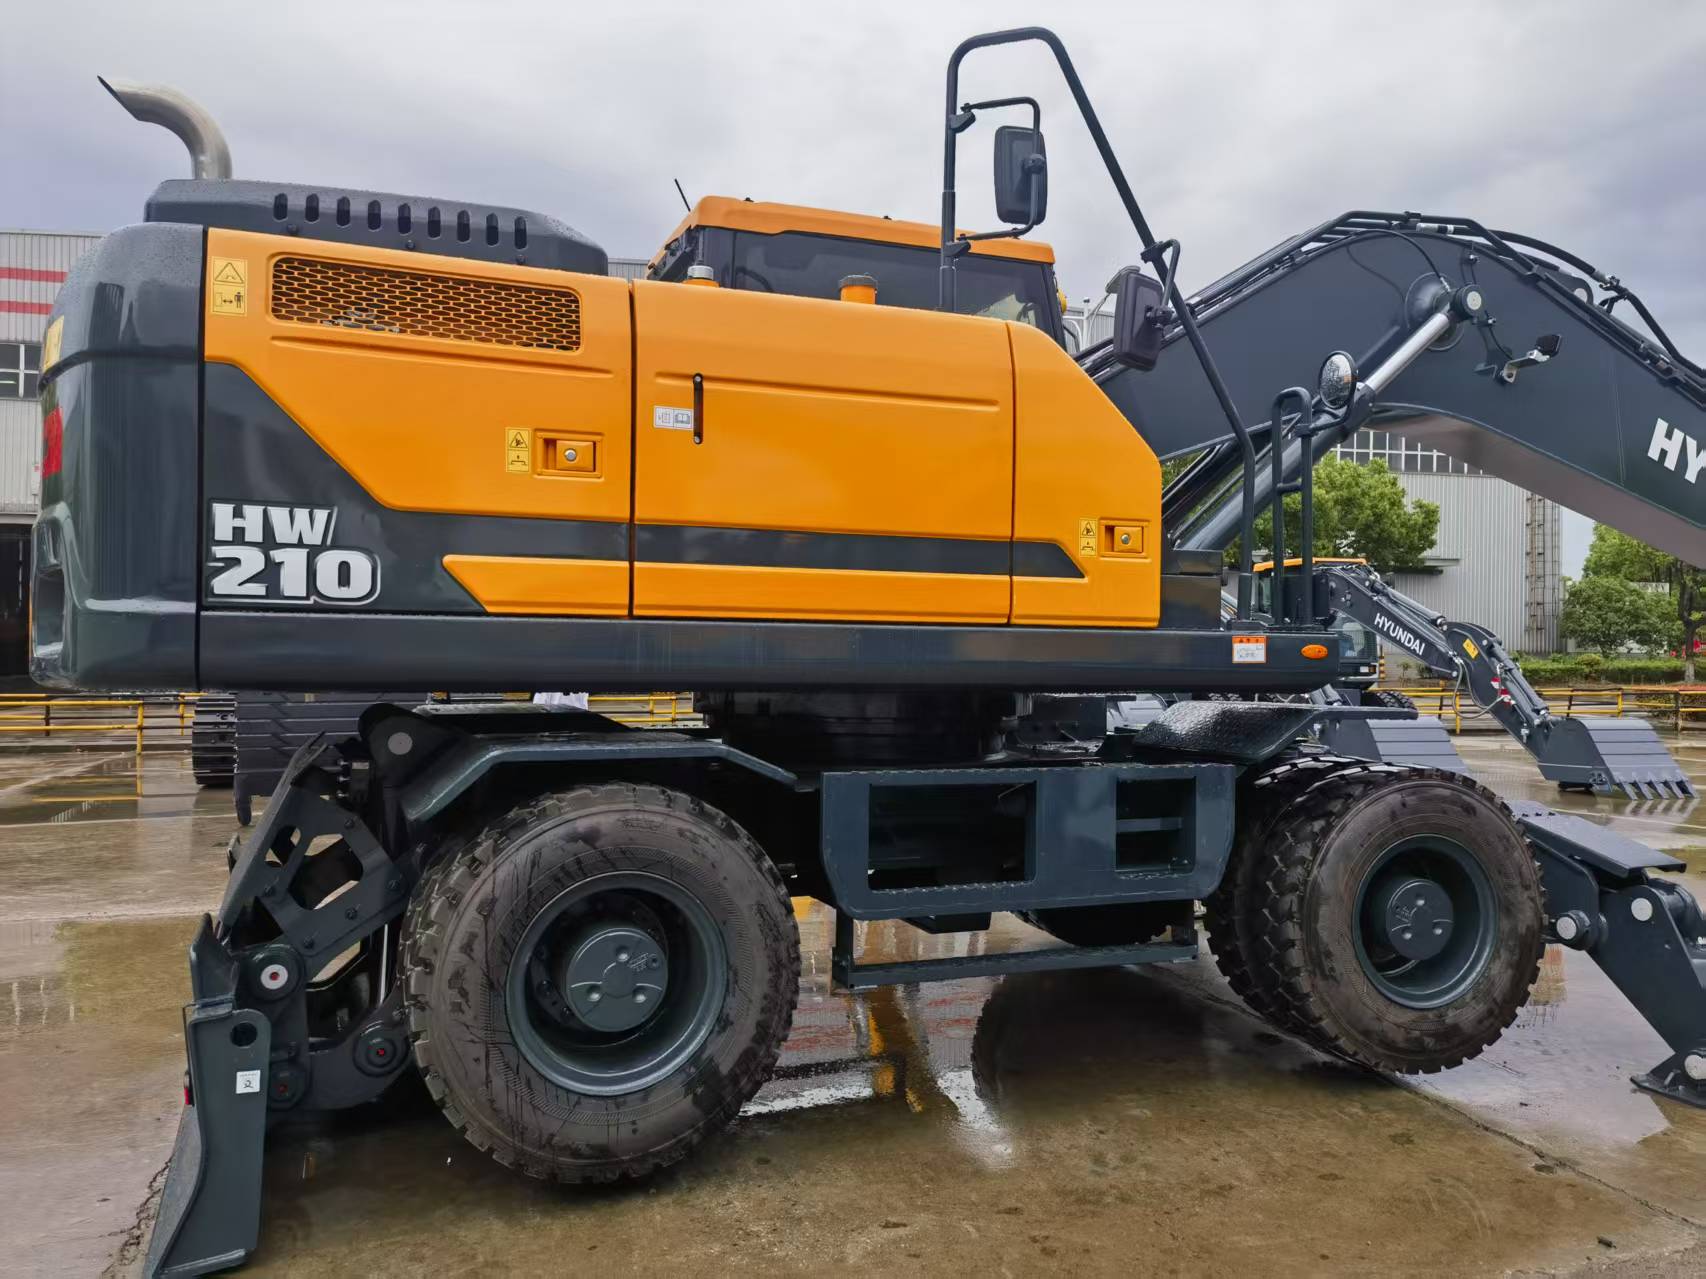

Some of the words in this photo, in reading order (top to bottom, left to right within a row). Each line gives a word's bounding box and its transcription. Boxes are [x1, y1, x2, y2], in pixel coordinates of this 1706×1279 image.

[211, 502, 332, 547] HW
[210, 544, 374, 600] 210
[1374, 612, 1426, 656] HYUNDAI
